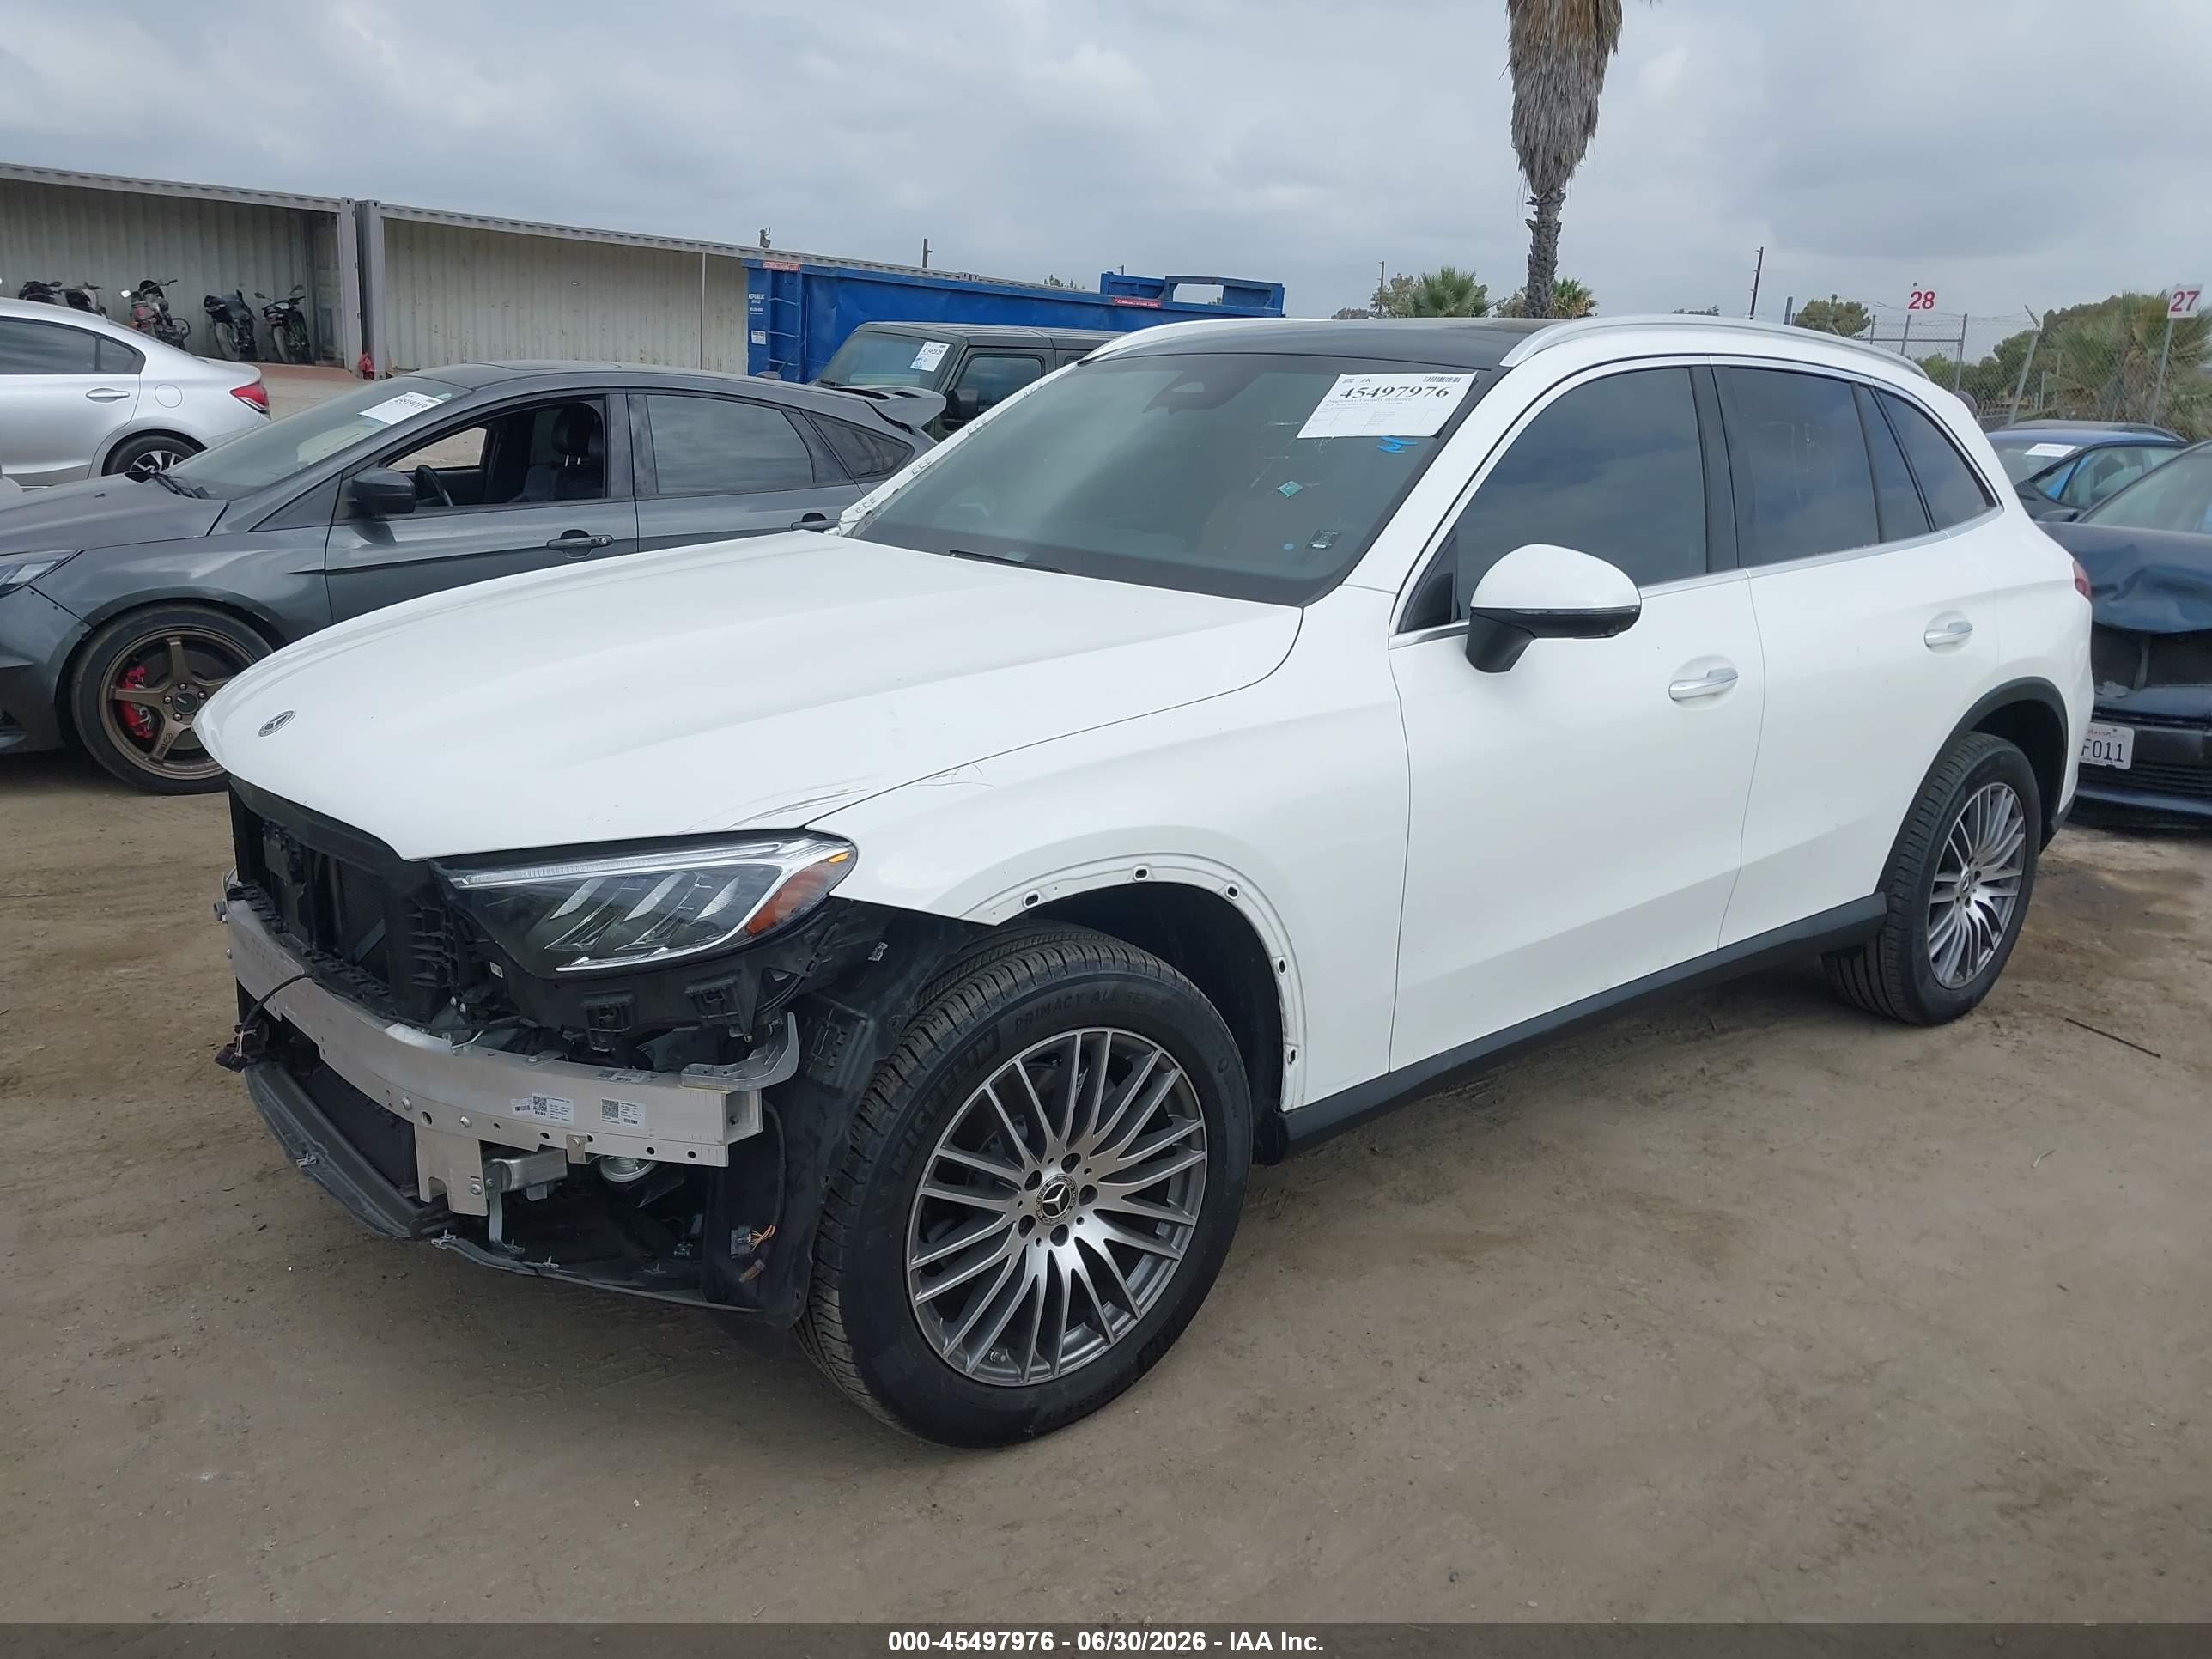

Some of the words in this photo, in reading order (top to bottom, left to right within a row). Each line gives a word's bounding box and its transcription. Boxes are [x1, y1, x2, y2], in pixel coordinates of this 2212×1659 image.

[1908, 291, 1936, 310] 28
[2170, 290, 2200, 312] 27
[1340, 386, 1449, 398] 45497976
[1013, 992, 1085, 1030] PRIMACY
[1091, 989, 1117, 1004] ALL
[891, 1036, 999, 1175] MICHELIN
